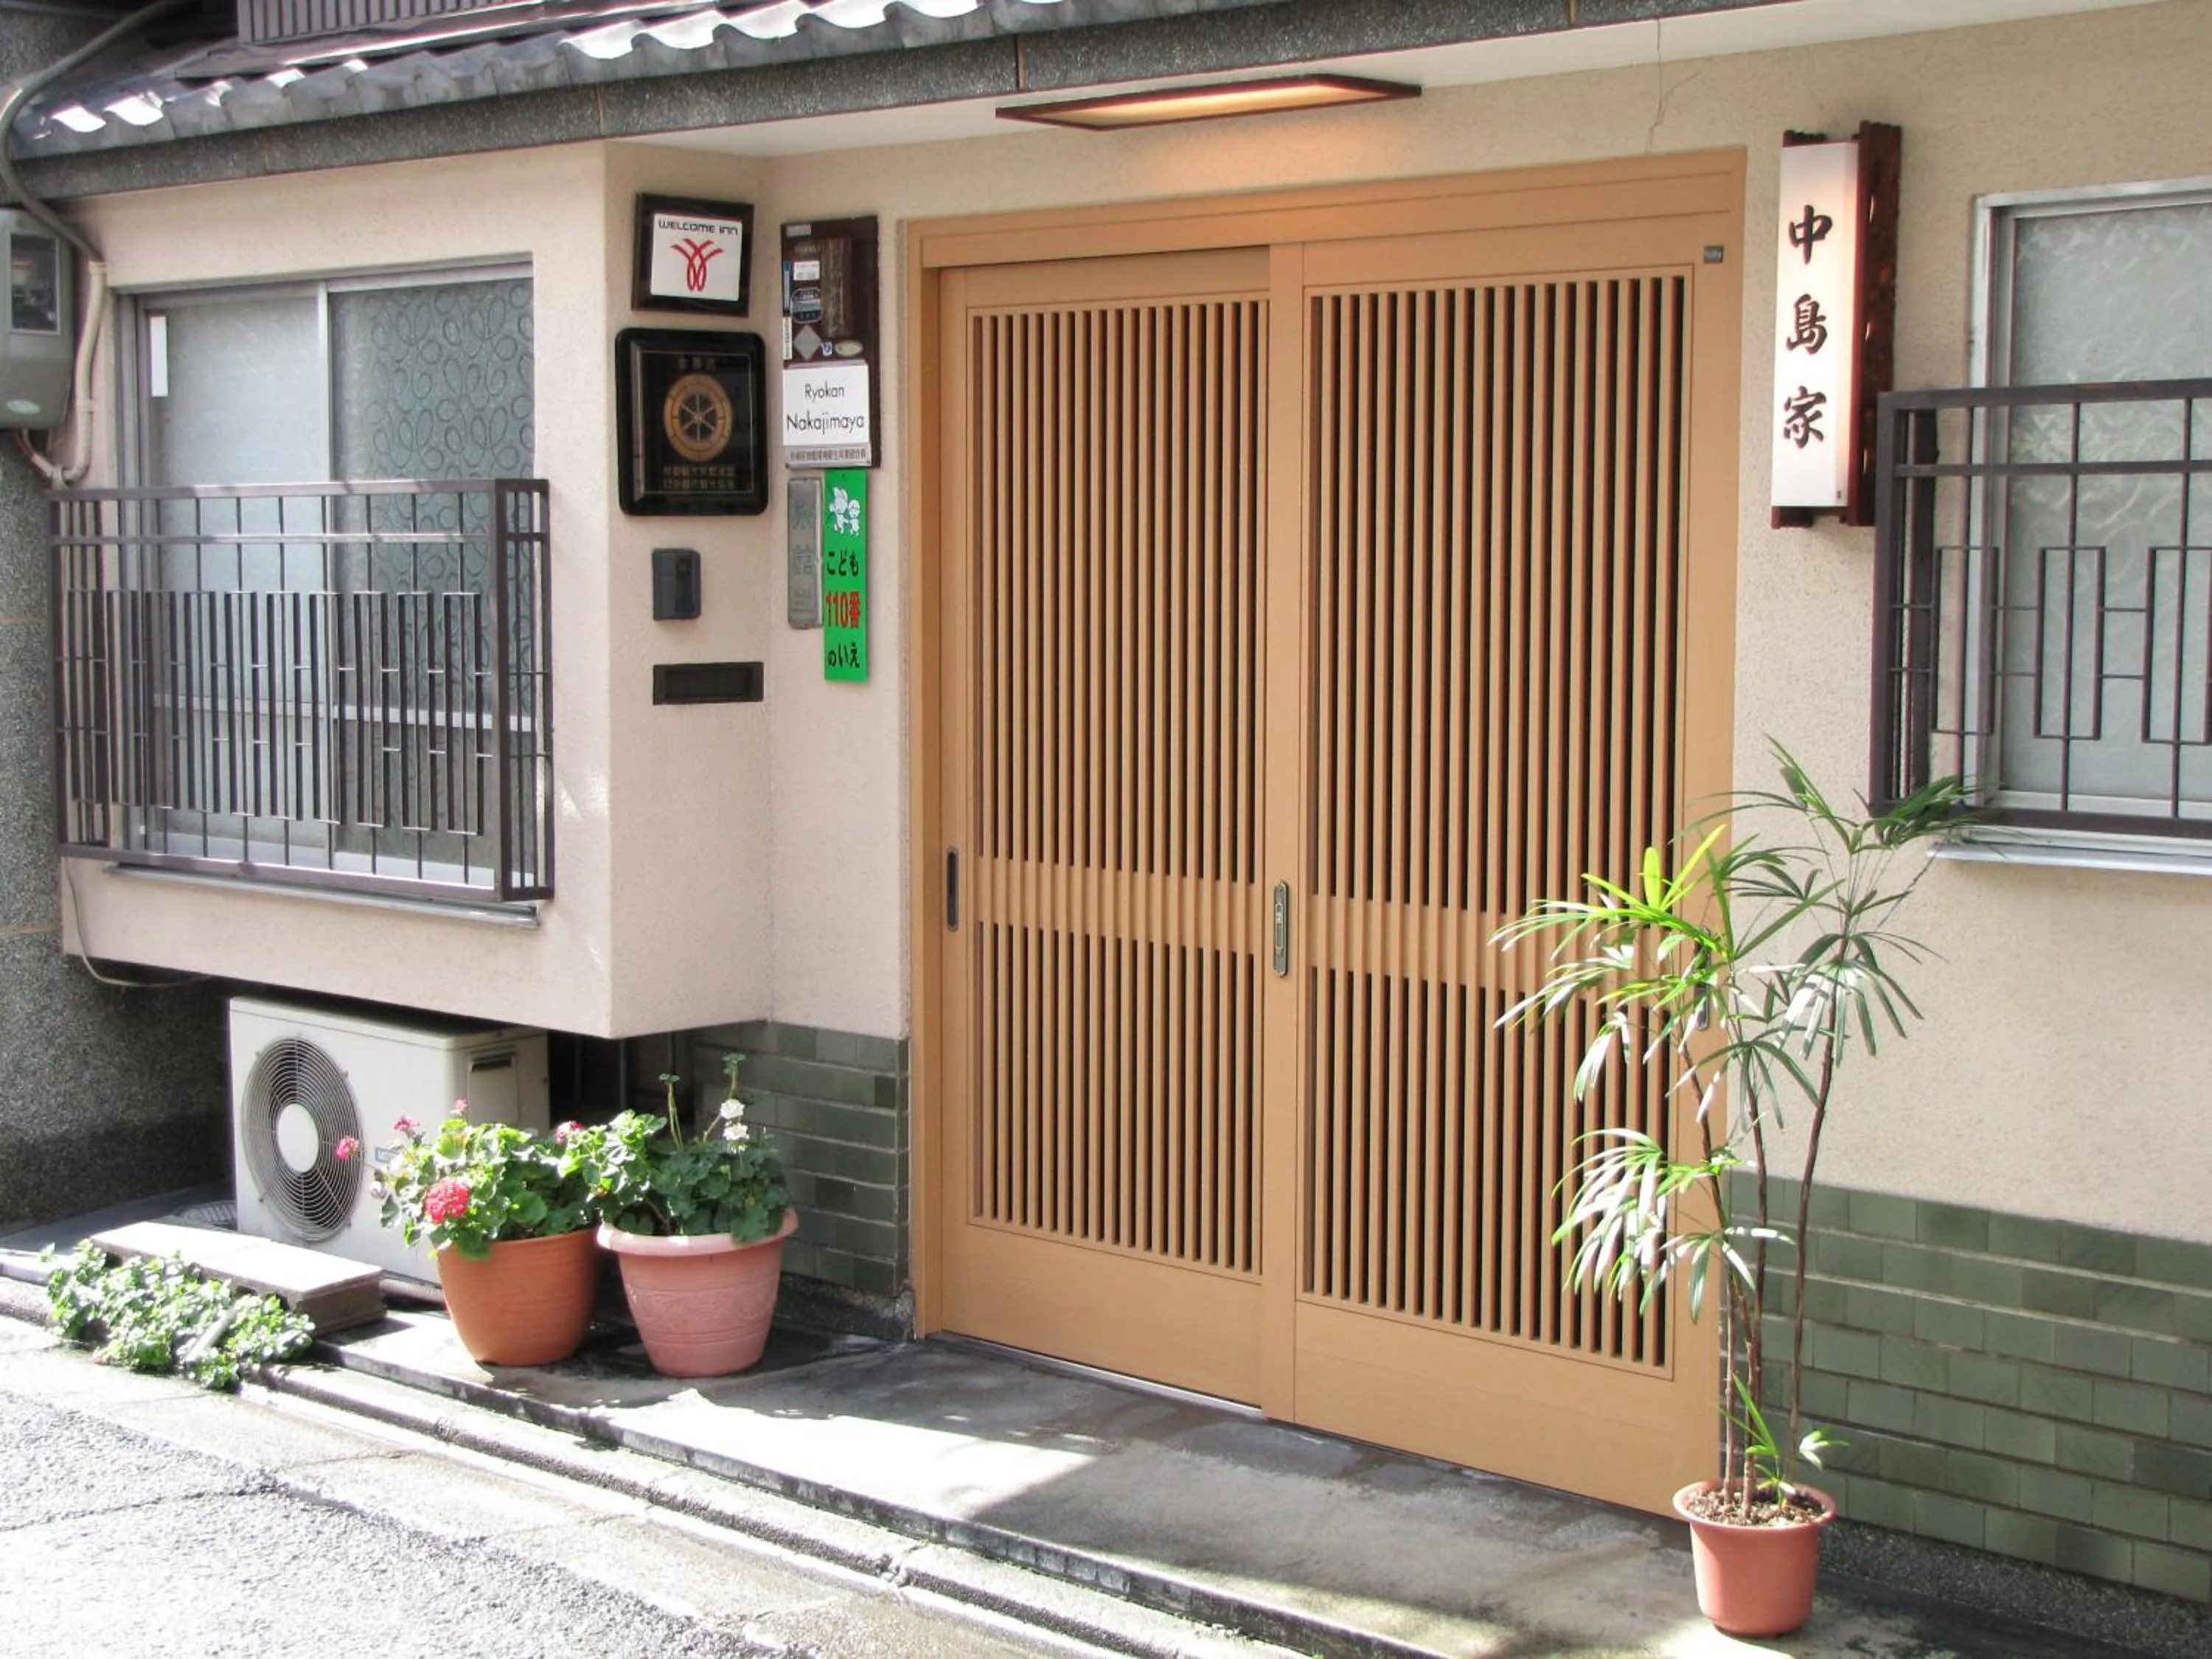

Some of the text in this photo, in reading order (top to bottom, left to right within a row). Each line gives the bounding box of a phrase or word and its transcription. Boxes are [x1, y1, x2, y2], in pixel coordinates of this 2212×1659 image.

[658, 219, 716, 234] WELCOME
[1783, 204, 1832, 449] 中島家
[804, 380, 845, 403] Ryokan
[786, 408, 865, 435] Nakajimaya
[827, 549, 859, 577] こども
[825, 590, 861, 629] 110番
[827, 641, 860, 669] のいえ
